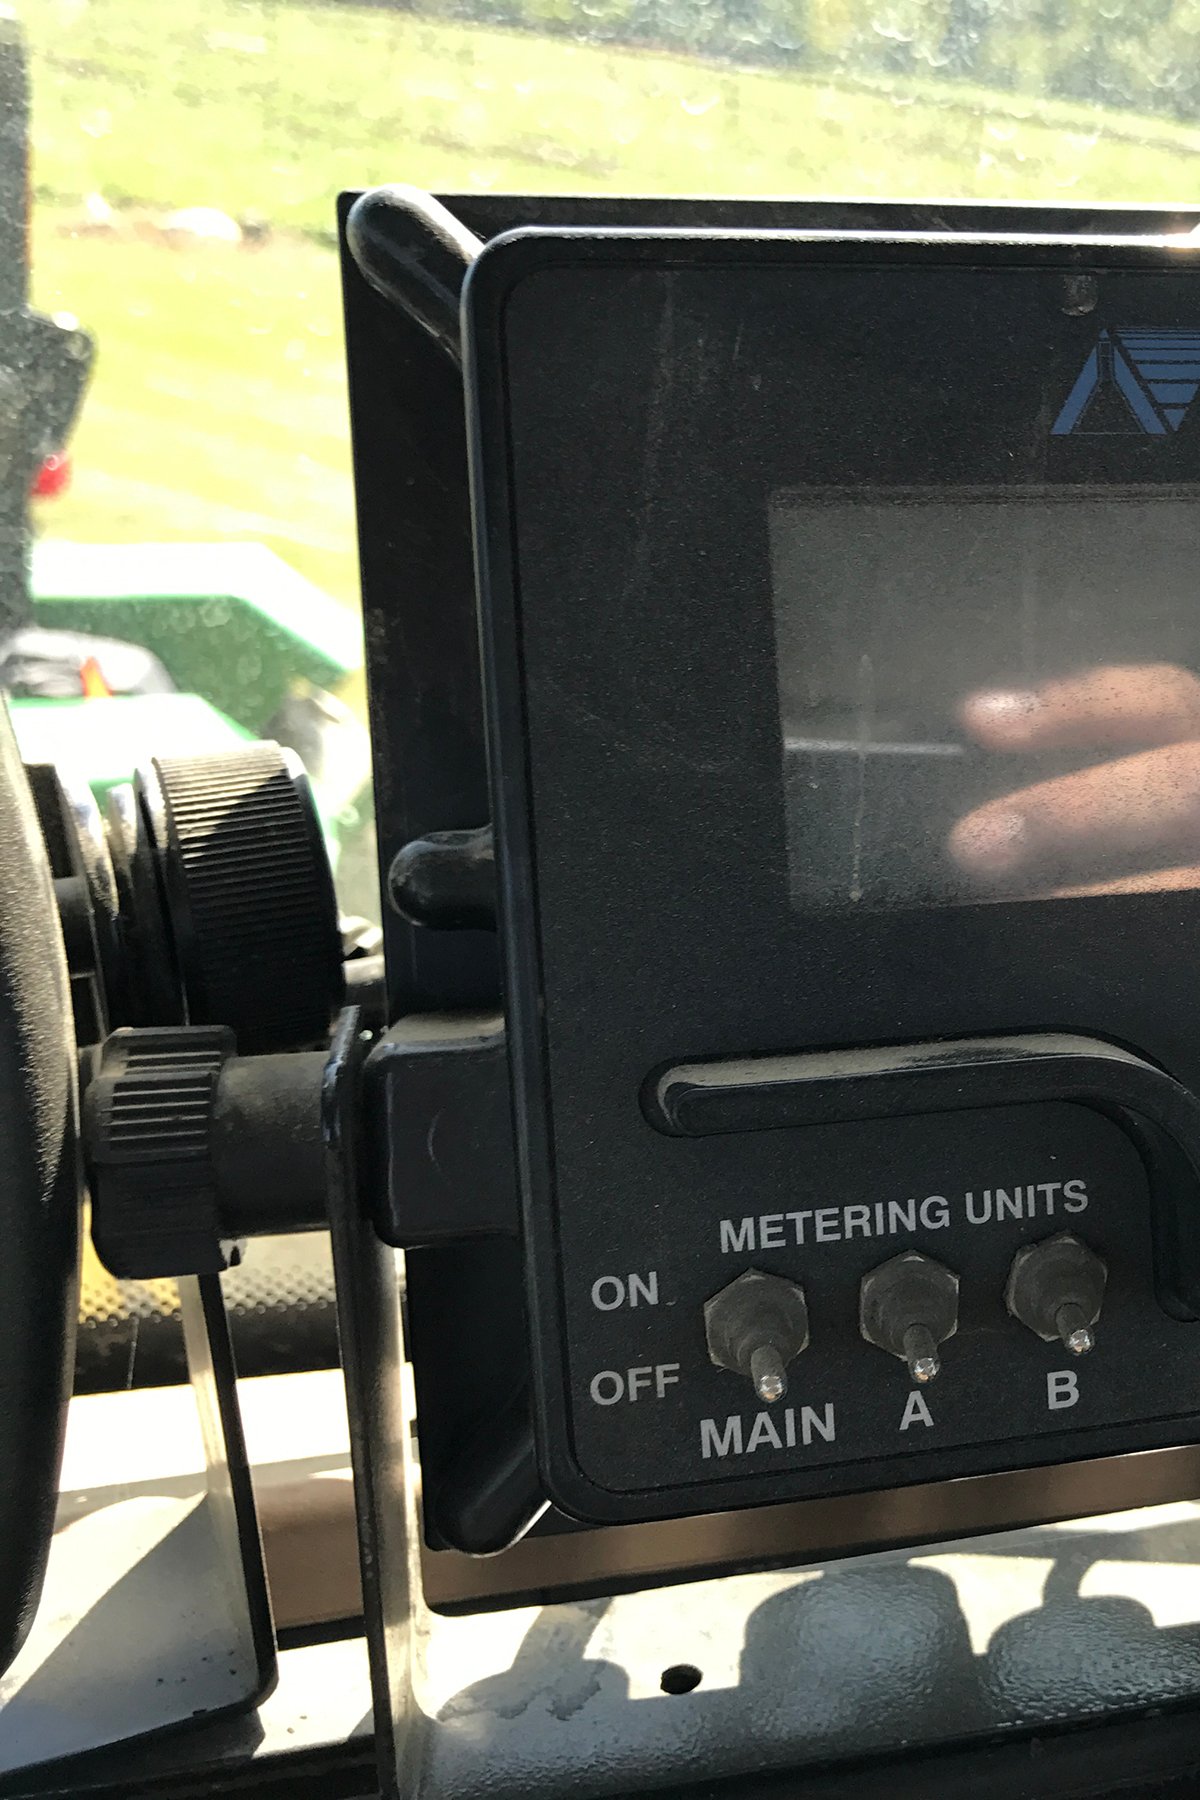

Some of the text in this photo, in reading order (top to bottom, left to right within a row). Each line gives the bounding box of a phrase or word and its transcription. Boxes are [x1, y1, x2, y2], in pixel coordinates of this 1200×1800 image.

[720, 1179, 1090, 1254] METERING UNITS
[590, 1270, 660, 1312] ON
[589, 1362, 681, 1407] OFF
[1045, 1370, 1082, 1410] B
[699, 1402, 836, 1460] MAIN
[898, 1391, 935, 1432] A
